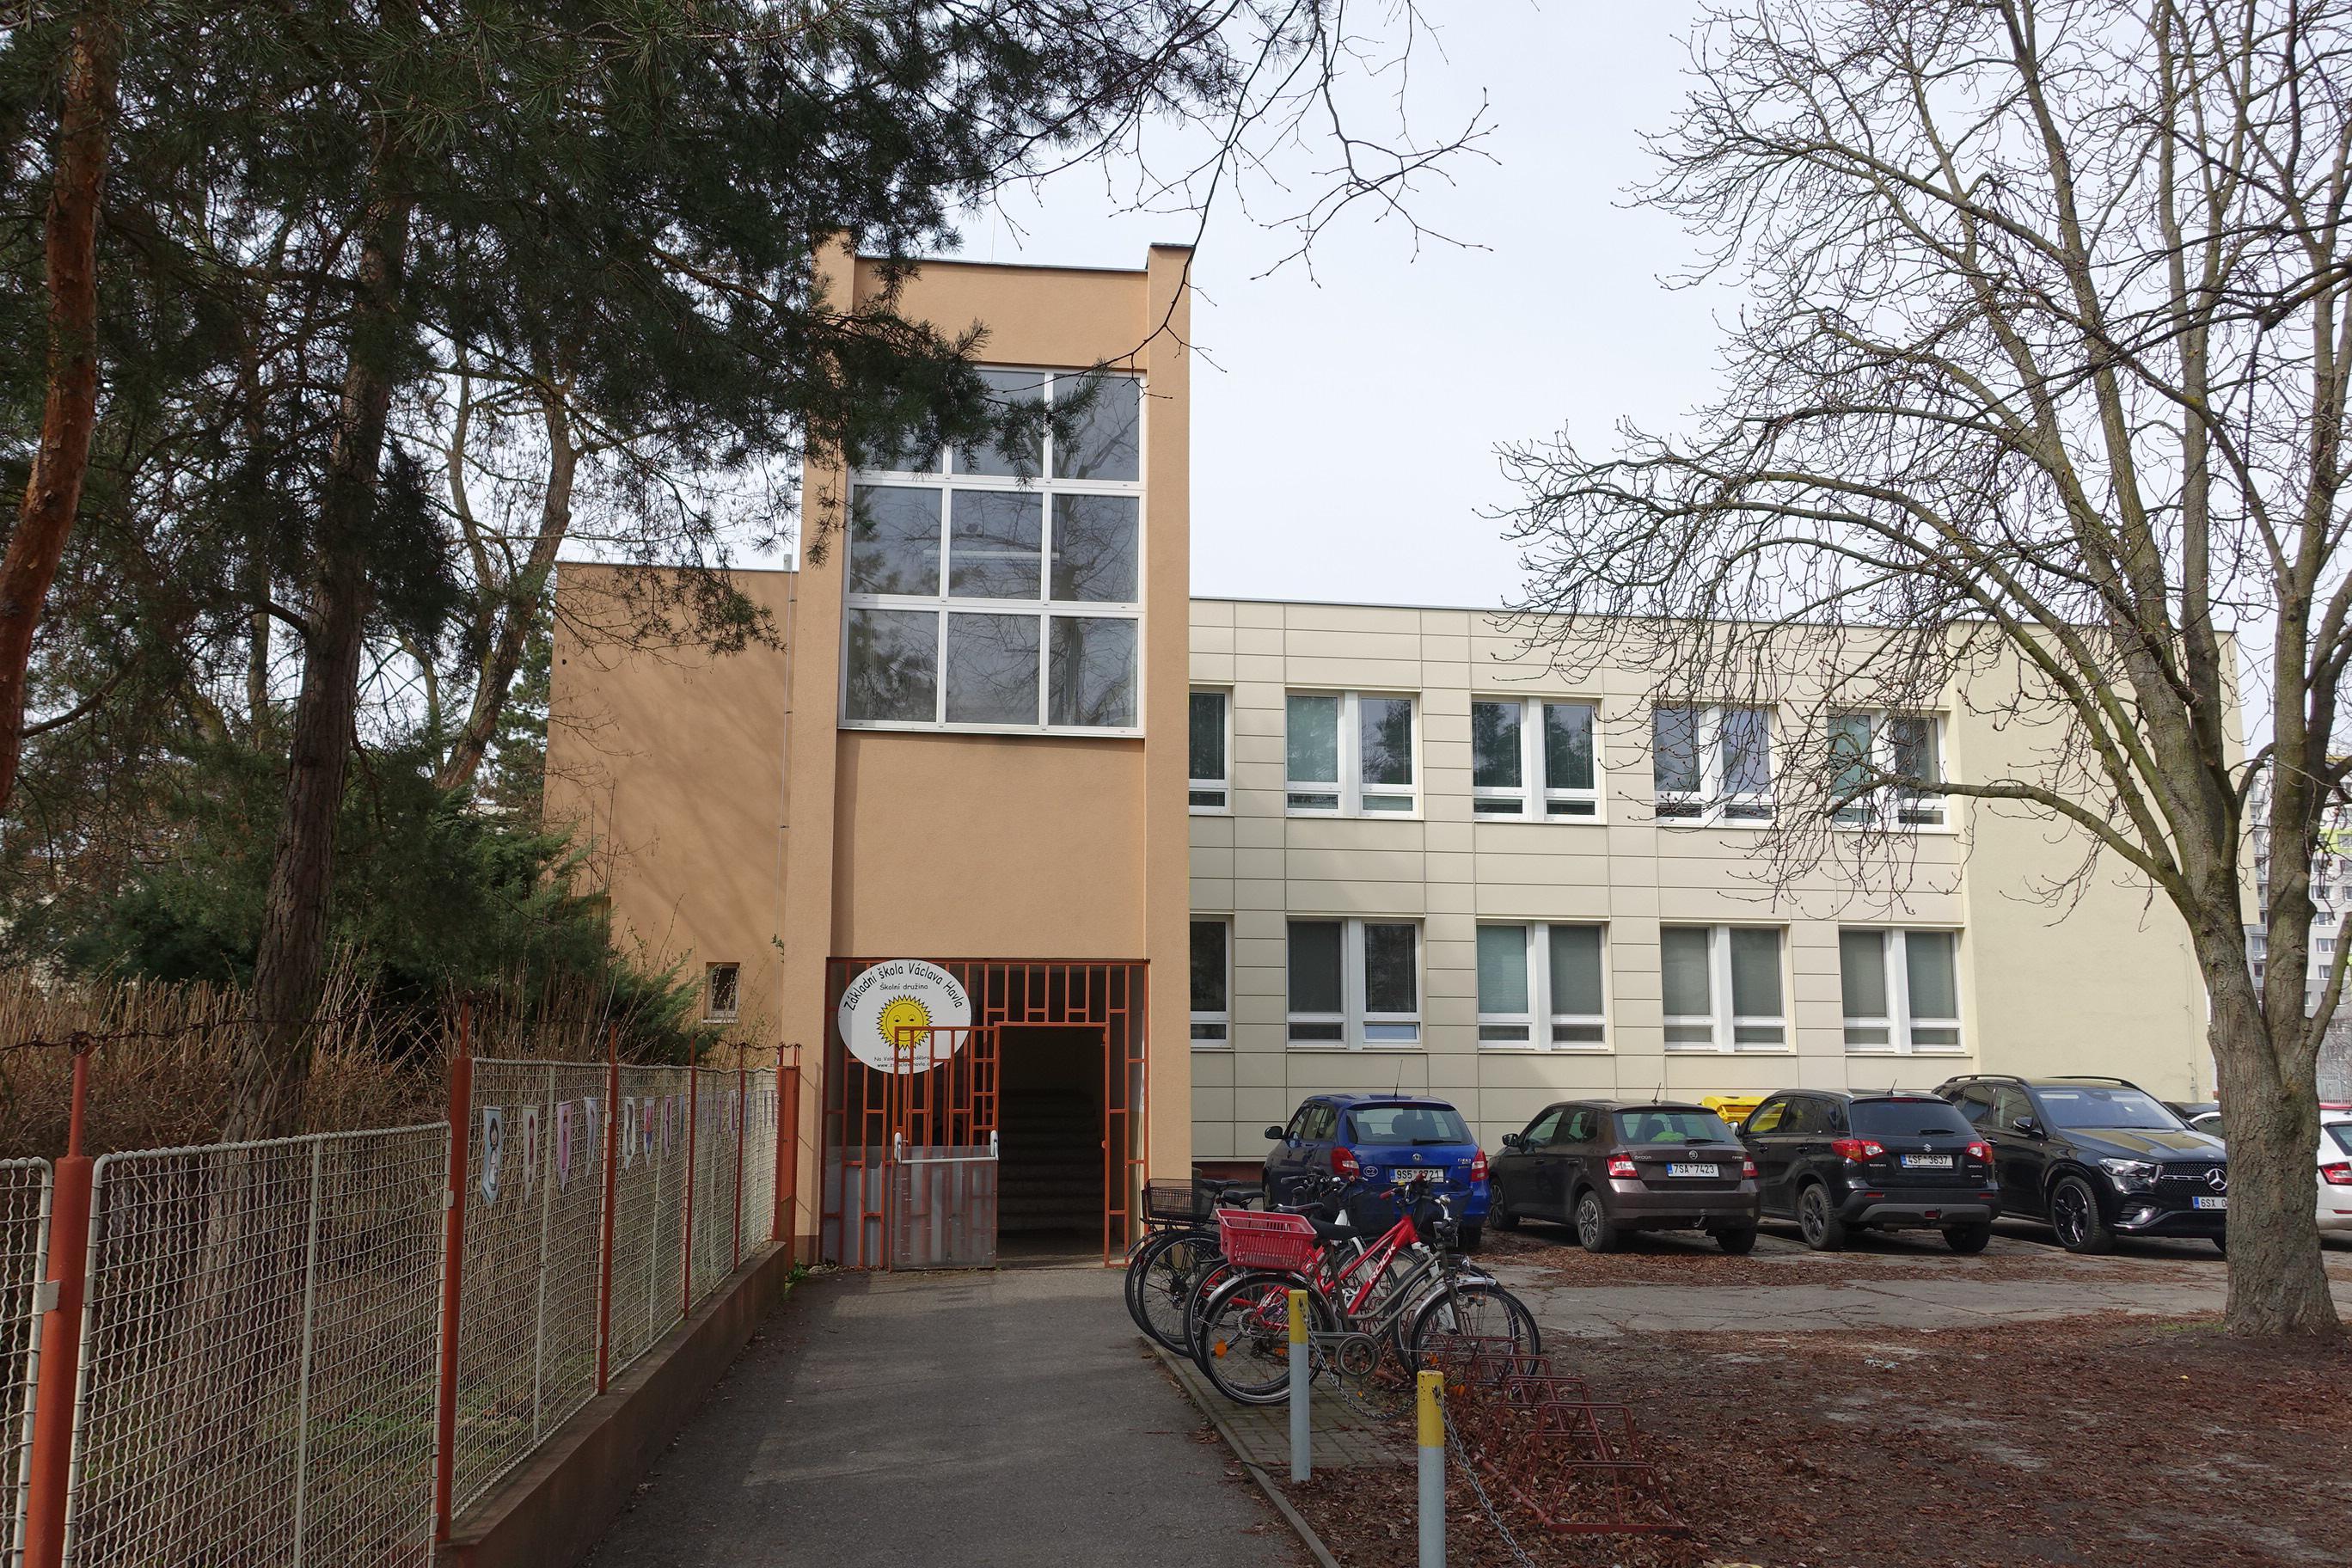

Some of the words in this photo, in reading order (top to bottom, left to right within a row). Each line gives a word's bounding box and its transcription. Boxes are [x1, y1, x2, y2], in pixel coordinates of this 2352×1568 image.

[843, 971, 878, 1011] Základní
[877, 963, 903, 980] škola
[909, 962, 943, 985] Václava
[943, 980, 963, 1008] Havla
[879, 982, 901, 990] Školní
[1908, 1155, 1922, 1164] 4SF
[1930, 1155, 1948, 1165] 3637
[1675, 1164, 1689, 1173] 7SA
[1695, 1164, 1714, 1174] 7423
[1397, 1170, 1412, 1179] 9S5
[2201, 1198, 2215, 1208] 6SX
